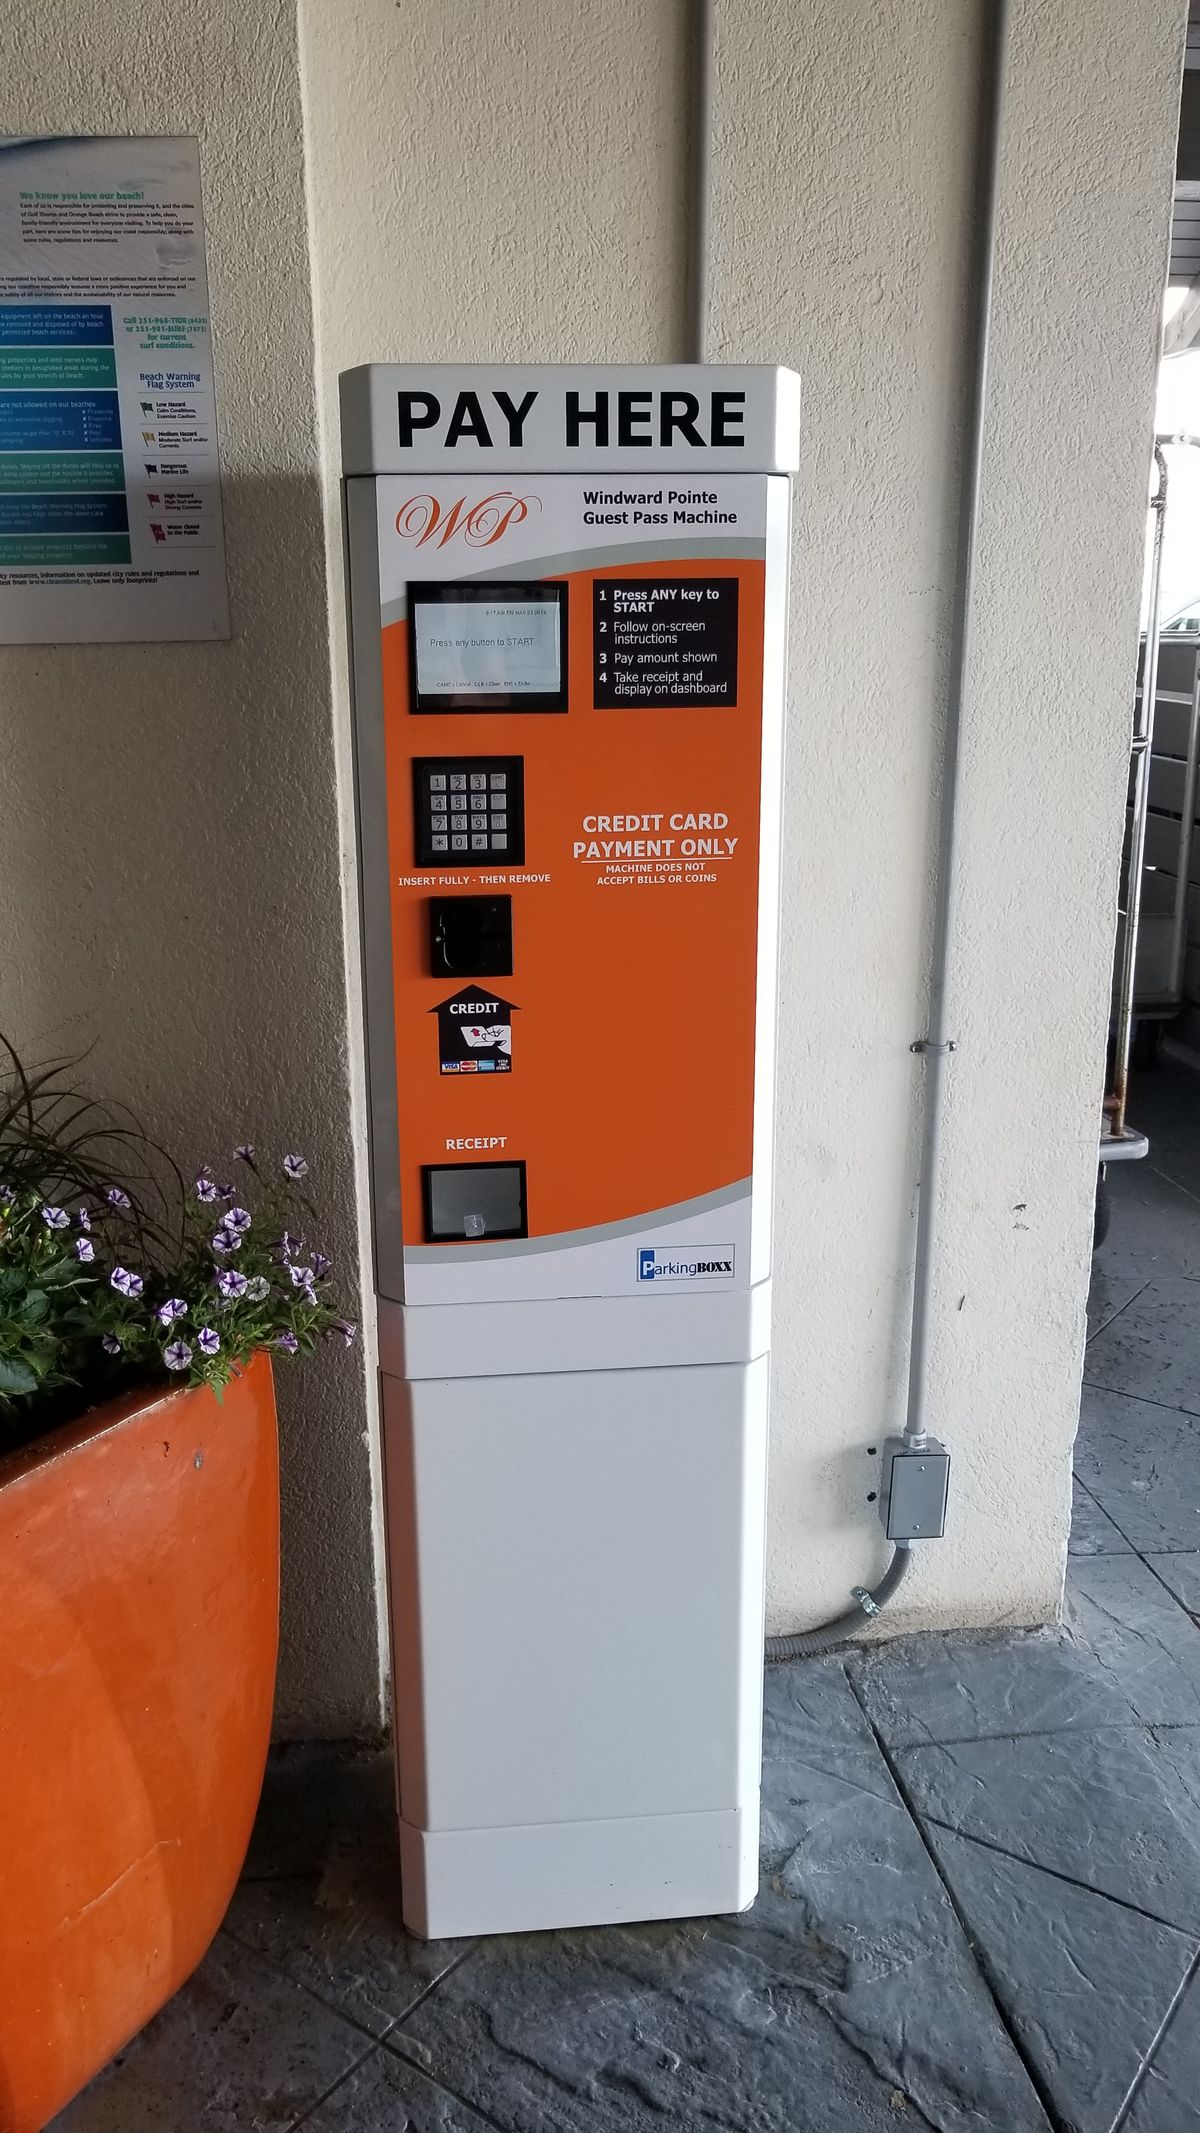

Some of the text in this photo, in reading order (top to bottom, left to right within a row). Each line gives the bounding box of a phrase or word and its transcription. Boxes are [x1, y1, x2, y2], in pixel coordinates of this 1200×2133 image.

[36, 191, 59, 199] know
[61, 193, 78, 201] you
[80, 191, 98, 199] love
[116, 191, 144, 200] beach!
[156, 341, 195, 349] conditions.
[140, 372, 201, 381] Beach Warning
[147, 381, 195, 389] Flag System
[397, 391, 745, 447] PAY HERE
[583, 490, 718, 504] Windward Pointe
[583, 510, 738, 524] Guest Pass Machine
[87, 571, 111, 579] updated
[599, 589, 720, 602] 1 Press ANY key to
[613, 602, 655, 613] START
[599, 621, 706, 632] 2 Follow on-screen
[430, 638, 453, 647] Press
[455, 640, 469, 648] any
[471, 639, 495, 647] button
[506, 638, 535, 646] START
[614, 633, 678, 645] instructions
[599, 652, 717, 666] 3 Pay amount shown
[599, 670, 703, 684] 4 Take receipt and
[614, 682, 727, 696] display on dashboard
[435, 778, 481, 790] 1 2 3
[435, 800, 481, 810] 4 5 6
[436, 820, 482, 830] 7 8 9
[582, 813, 729, 833] CREDIT CARD
[456, 838, 463, 847] 0
[573, 838, 739, 859] PAYMENT ONLY
[606, 863, 705, 873] MACHINE DOES NOT
[398, 874, 551, 886] INSERT FULLY THEN REMOVE
[597, 874, 717, 885] ACCEPT BILLS OR COINS
[449, 1002, 499, 1014] CREDIT
[446, 1136, 507, 1150] RECEIPT
[642, 1261, 732, 1276] ParkingBOXX
